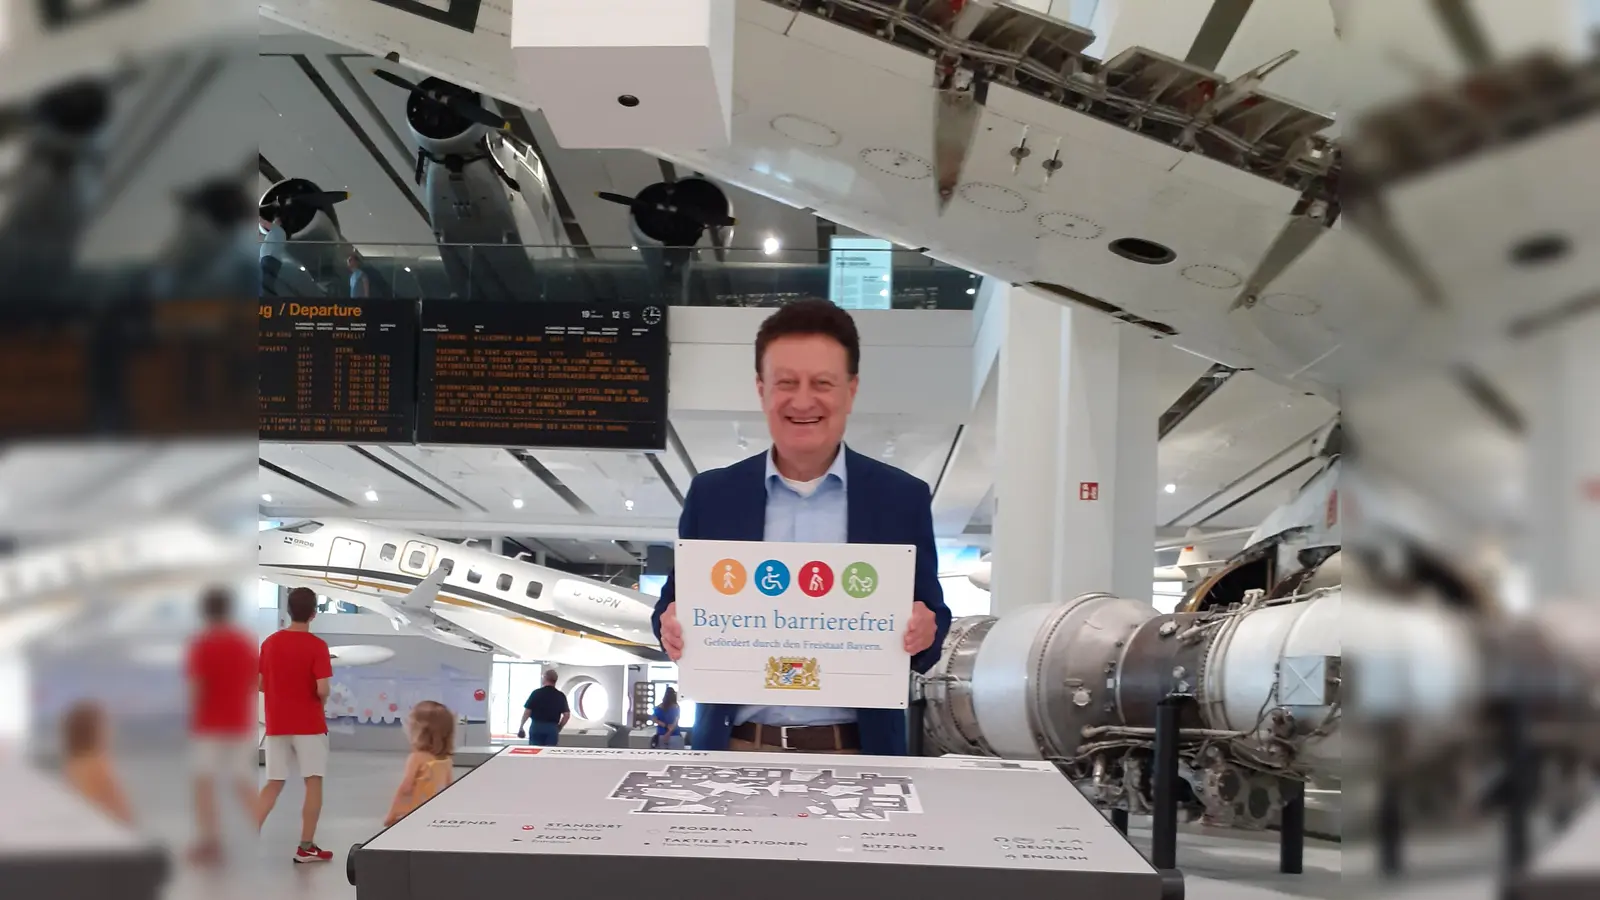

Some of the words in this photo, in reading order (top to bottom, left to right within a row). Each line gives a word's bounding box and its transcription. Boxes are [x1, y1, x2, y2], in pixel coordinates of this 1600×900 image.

[289, 303, 362, 319] Departure
[612, 311, 620, 319] 12
[693, 608, 767, 633] Bayern
[774, 610, 895, 632] barrierefrei
[703, 637, 751, 648] Gefördert
[752, 639, 780, 648] durch
[782, 640, 800, 649] den
[803, 640, 844, 650] Freistaat
[846, 642, 883, 653] Bayern.
[724, 839, 809, 847] STATIONEN
[1022, 853, 1089, 861] ENGLISH
